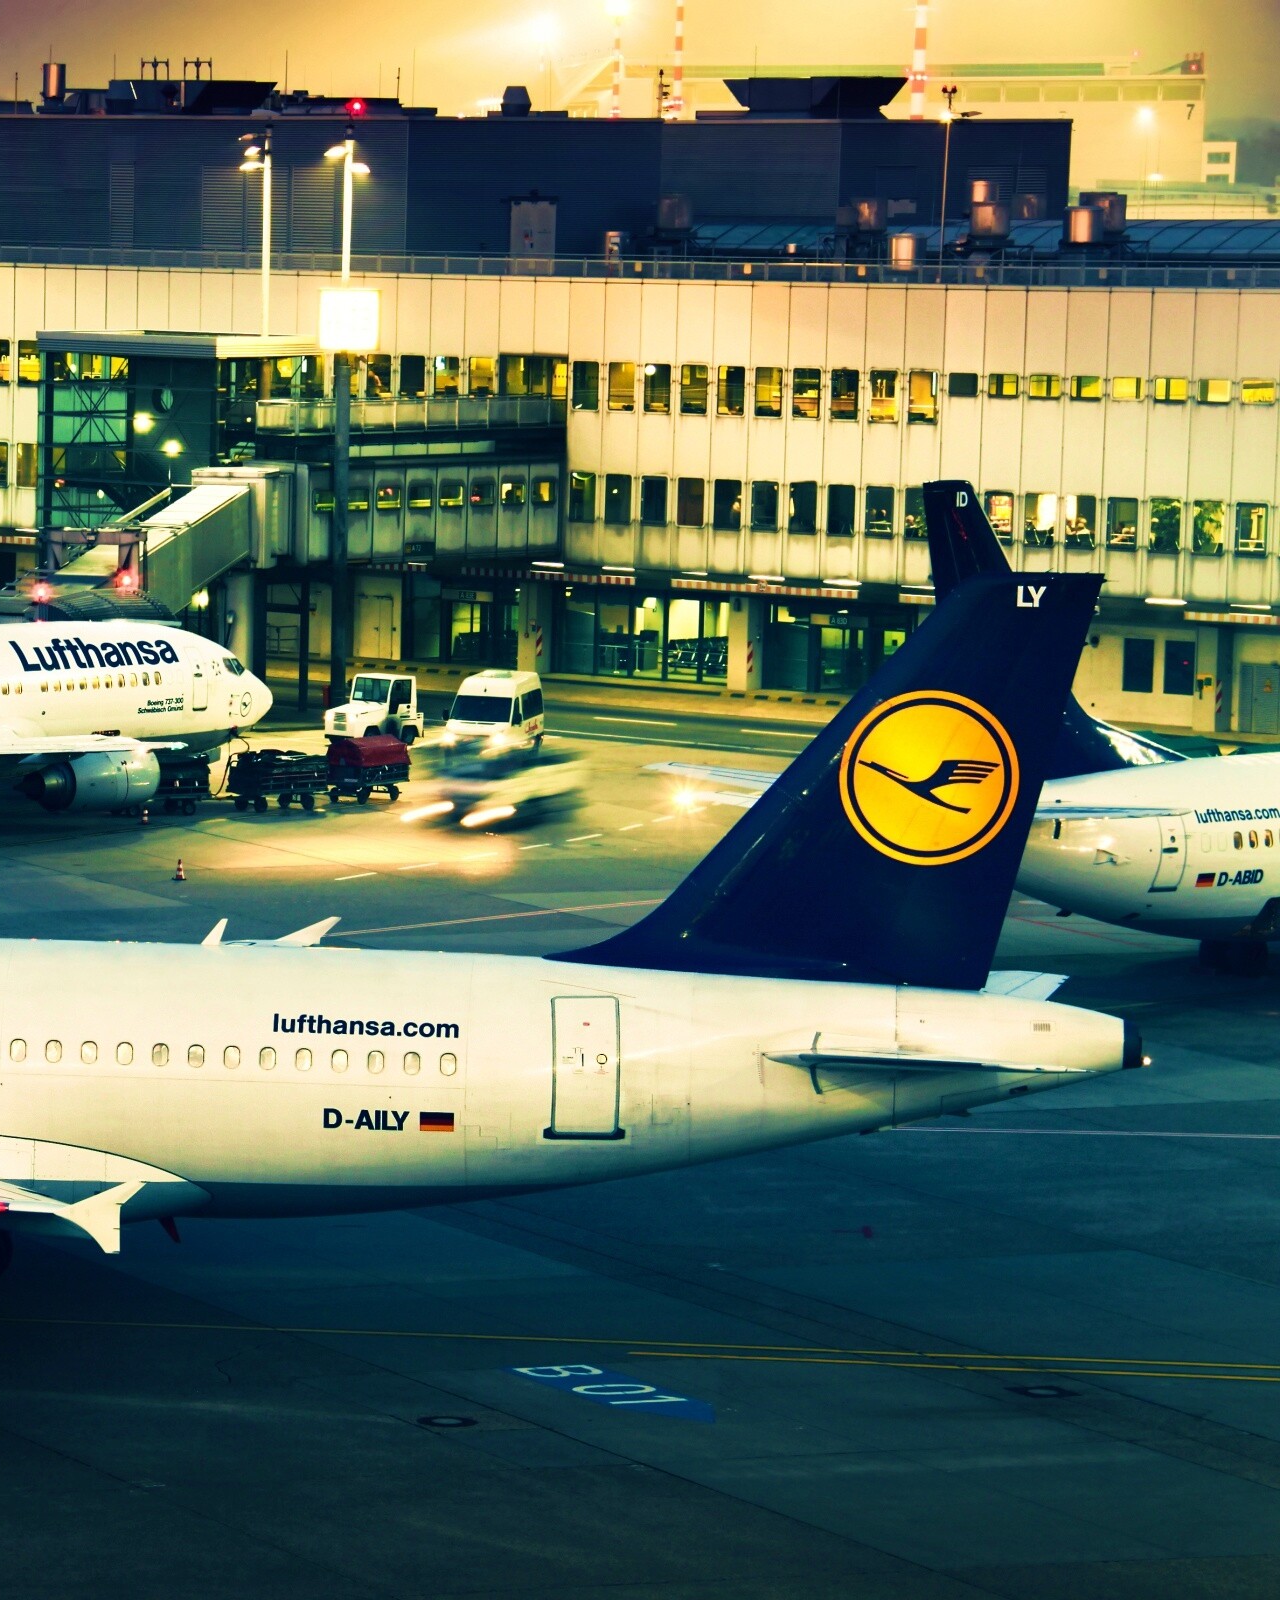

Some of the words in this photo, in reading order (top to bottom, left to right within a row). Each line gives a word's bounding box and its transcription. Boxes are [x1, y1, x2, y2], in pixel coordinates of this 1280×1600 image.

[1186, 103, 1195, 120] 7
[956, 491, 968, 507] ID
[1016, 585, 1047, 608] LY
[8, 637, 180, 672] Lufthansa
[1194, 808, 1280, 824] lufthansa.com
[1217, 869, 1264, 887] D-ABID
[273, 1013, 460, 1038] lufthansa.com
[323, 1108, 410, 1131] D-AILY
[513, 1364, 603, 1377] B
